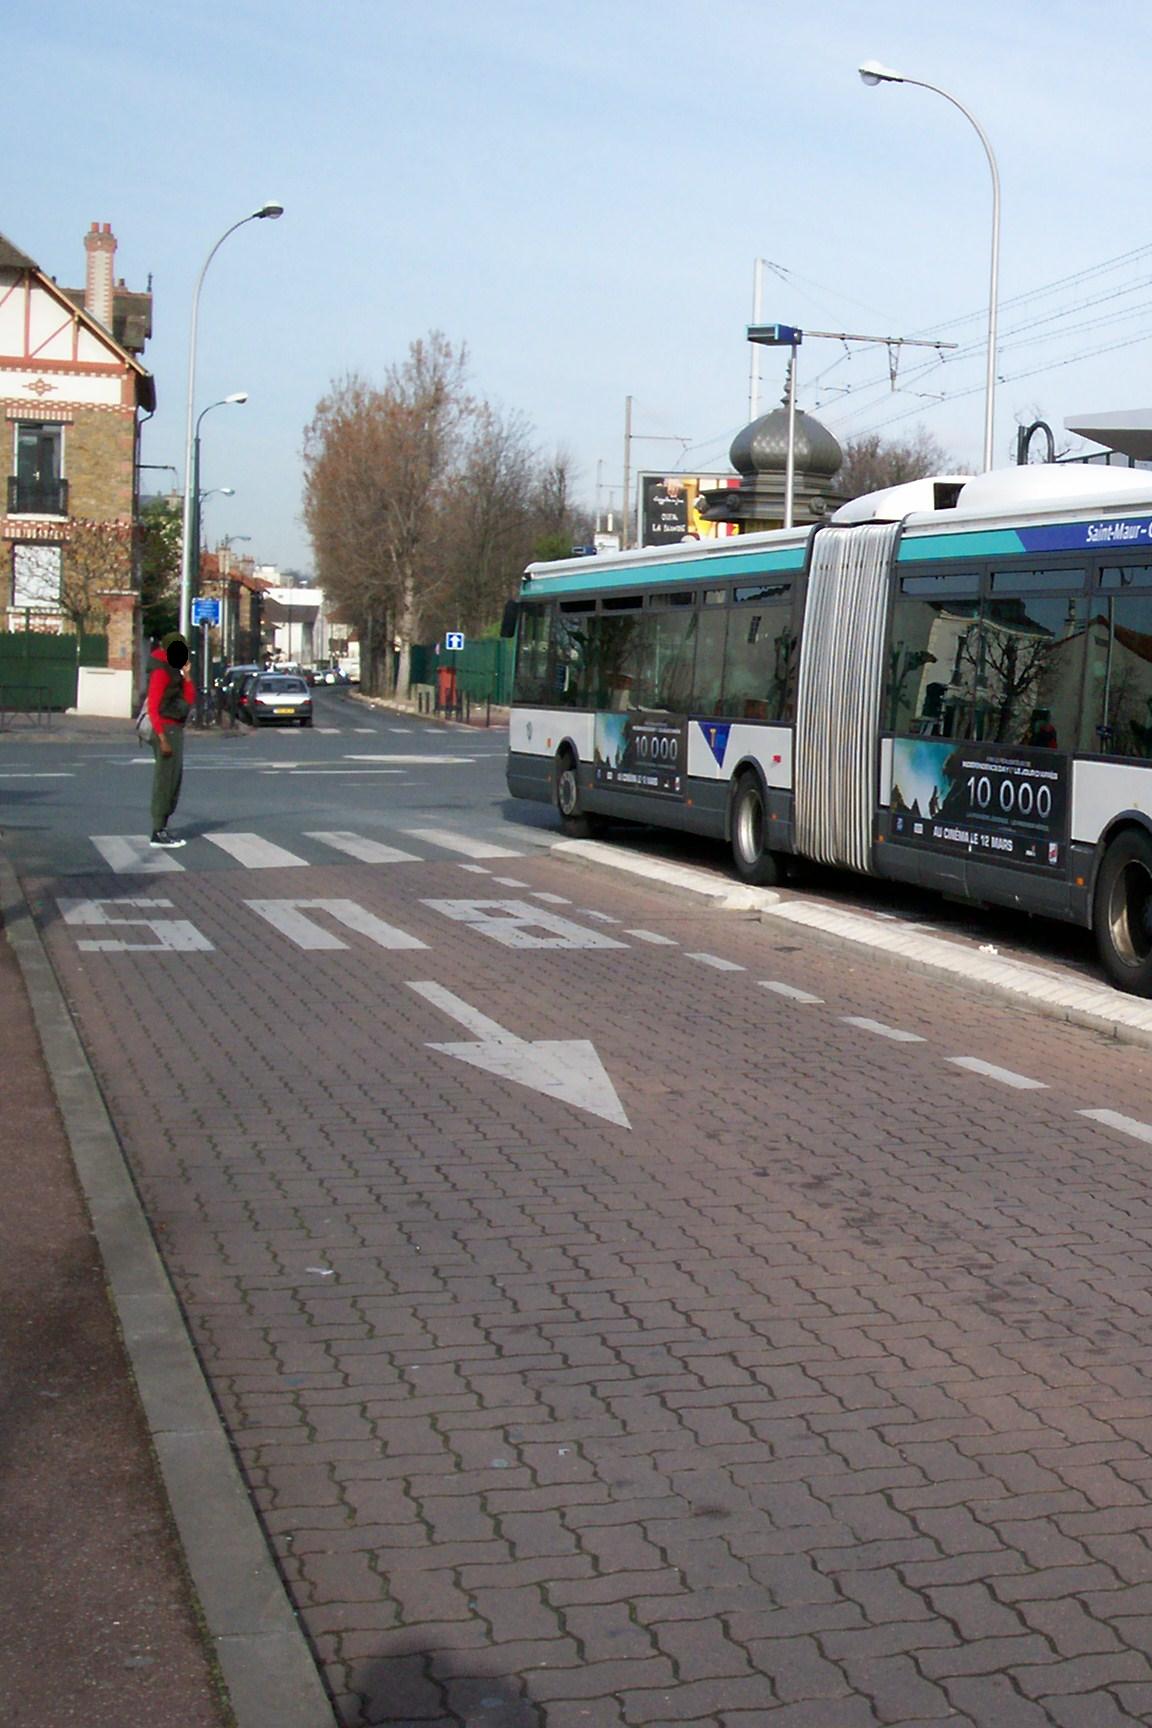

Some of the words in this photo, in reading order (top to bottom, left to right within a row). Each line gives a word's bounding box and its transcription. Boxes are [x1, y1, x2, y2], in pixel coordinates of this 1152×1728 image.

[635, 735, 648, 758] 10
[651, 736, 677, 760] 000
[967, 776, 991, 808] 10
[1000, 779, 1051, 818] 000
[933, 825, 942, 838] AU
[943, 827, 969, 842] CINÉMA
[970, 832, 978, 845] LE
[980, 834, 989, 847] 12
[991, 836, 1013, 851] MARS
